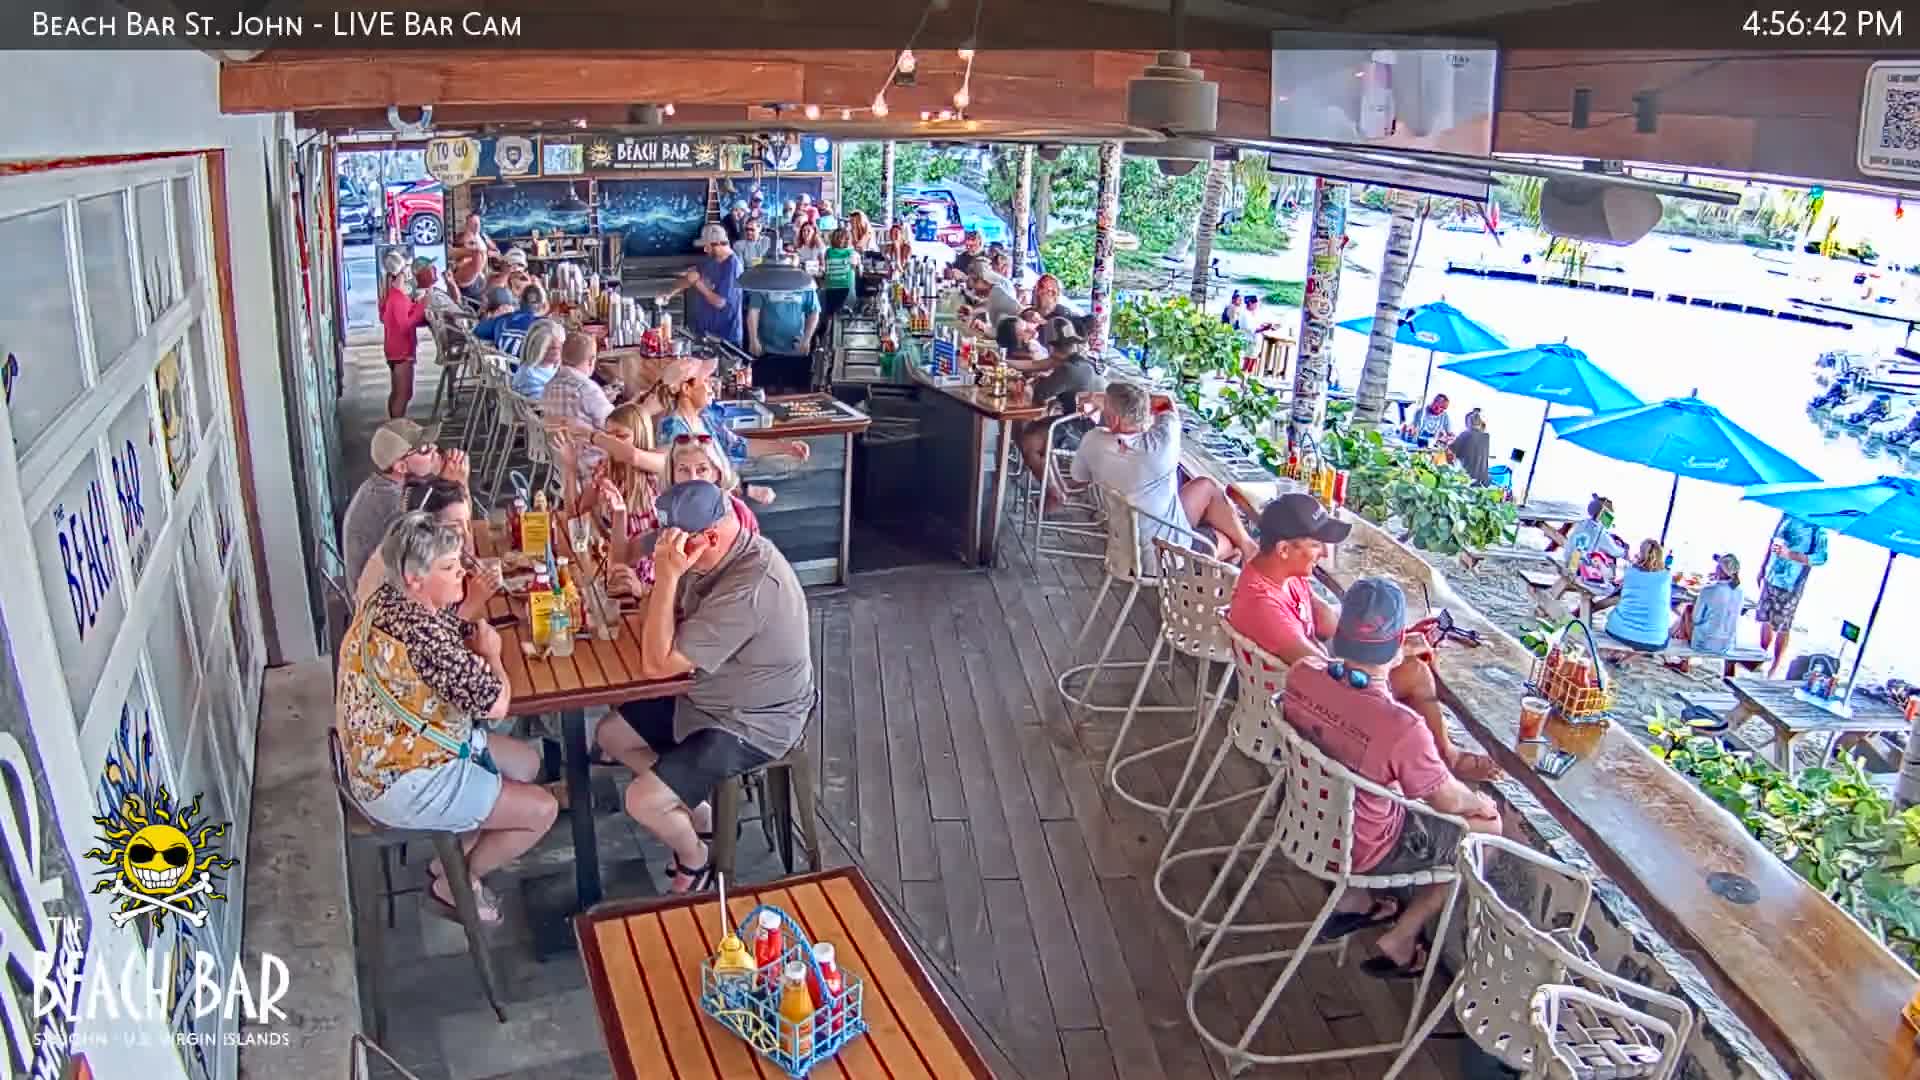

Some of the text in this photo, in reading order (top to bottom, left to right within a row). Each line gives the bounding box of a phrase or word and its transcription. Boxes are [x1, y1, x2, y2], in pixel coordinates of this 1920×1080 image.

[617, 143, 691, 161] BEACH BAR
[58, 479, 116, 643] BEACH
[112, 439, 145, 544] BAR
